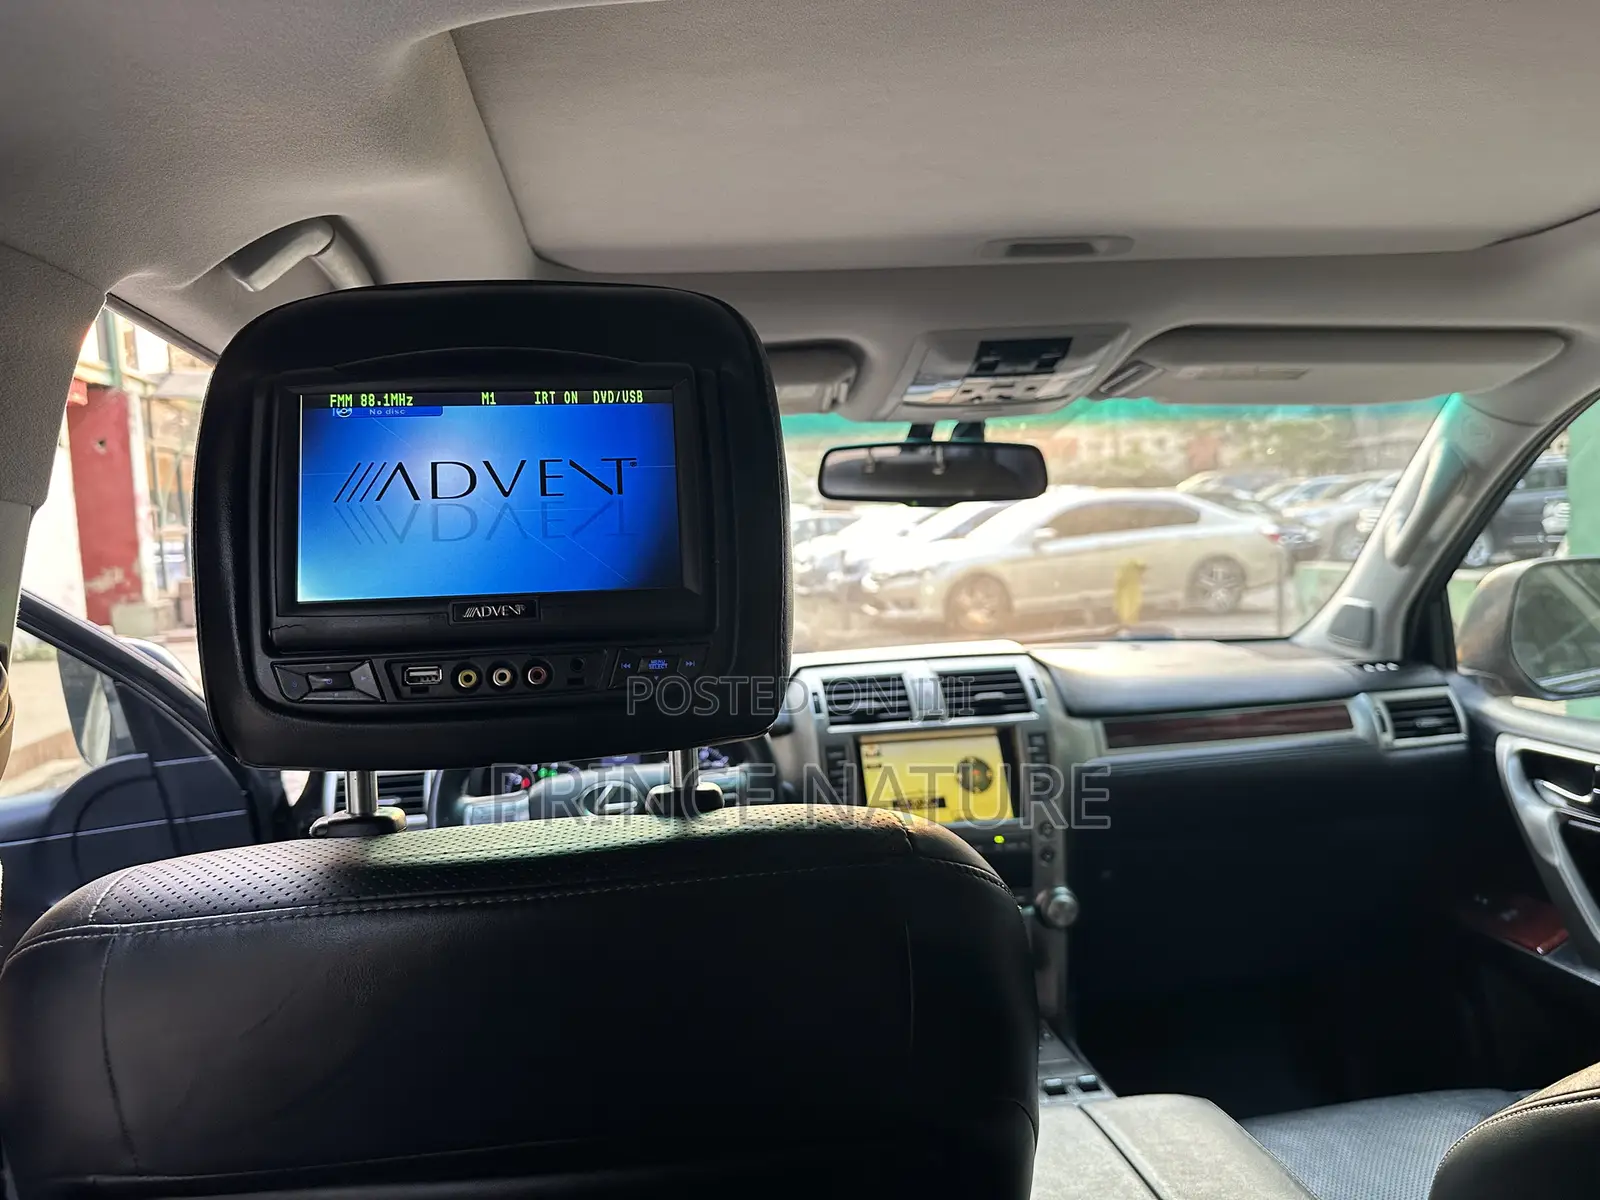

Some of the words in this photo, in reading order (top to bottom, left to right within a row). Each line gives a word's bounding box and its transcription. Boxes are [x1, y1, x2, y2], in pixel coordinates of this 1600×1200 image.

[330, 394, 353, 408] FMM
[360, 393, 414, 407] 88.1MHz
[481, 391, 497, 405] M1
[534, 391, 556, 405] IRT
[564, 391, 579, 404] ON
[593, 390, 644, 404] DVD/USB
[385, 407, 406, 415] disc
